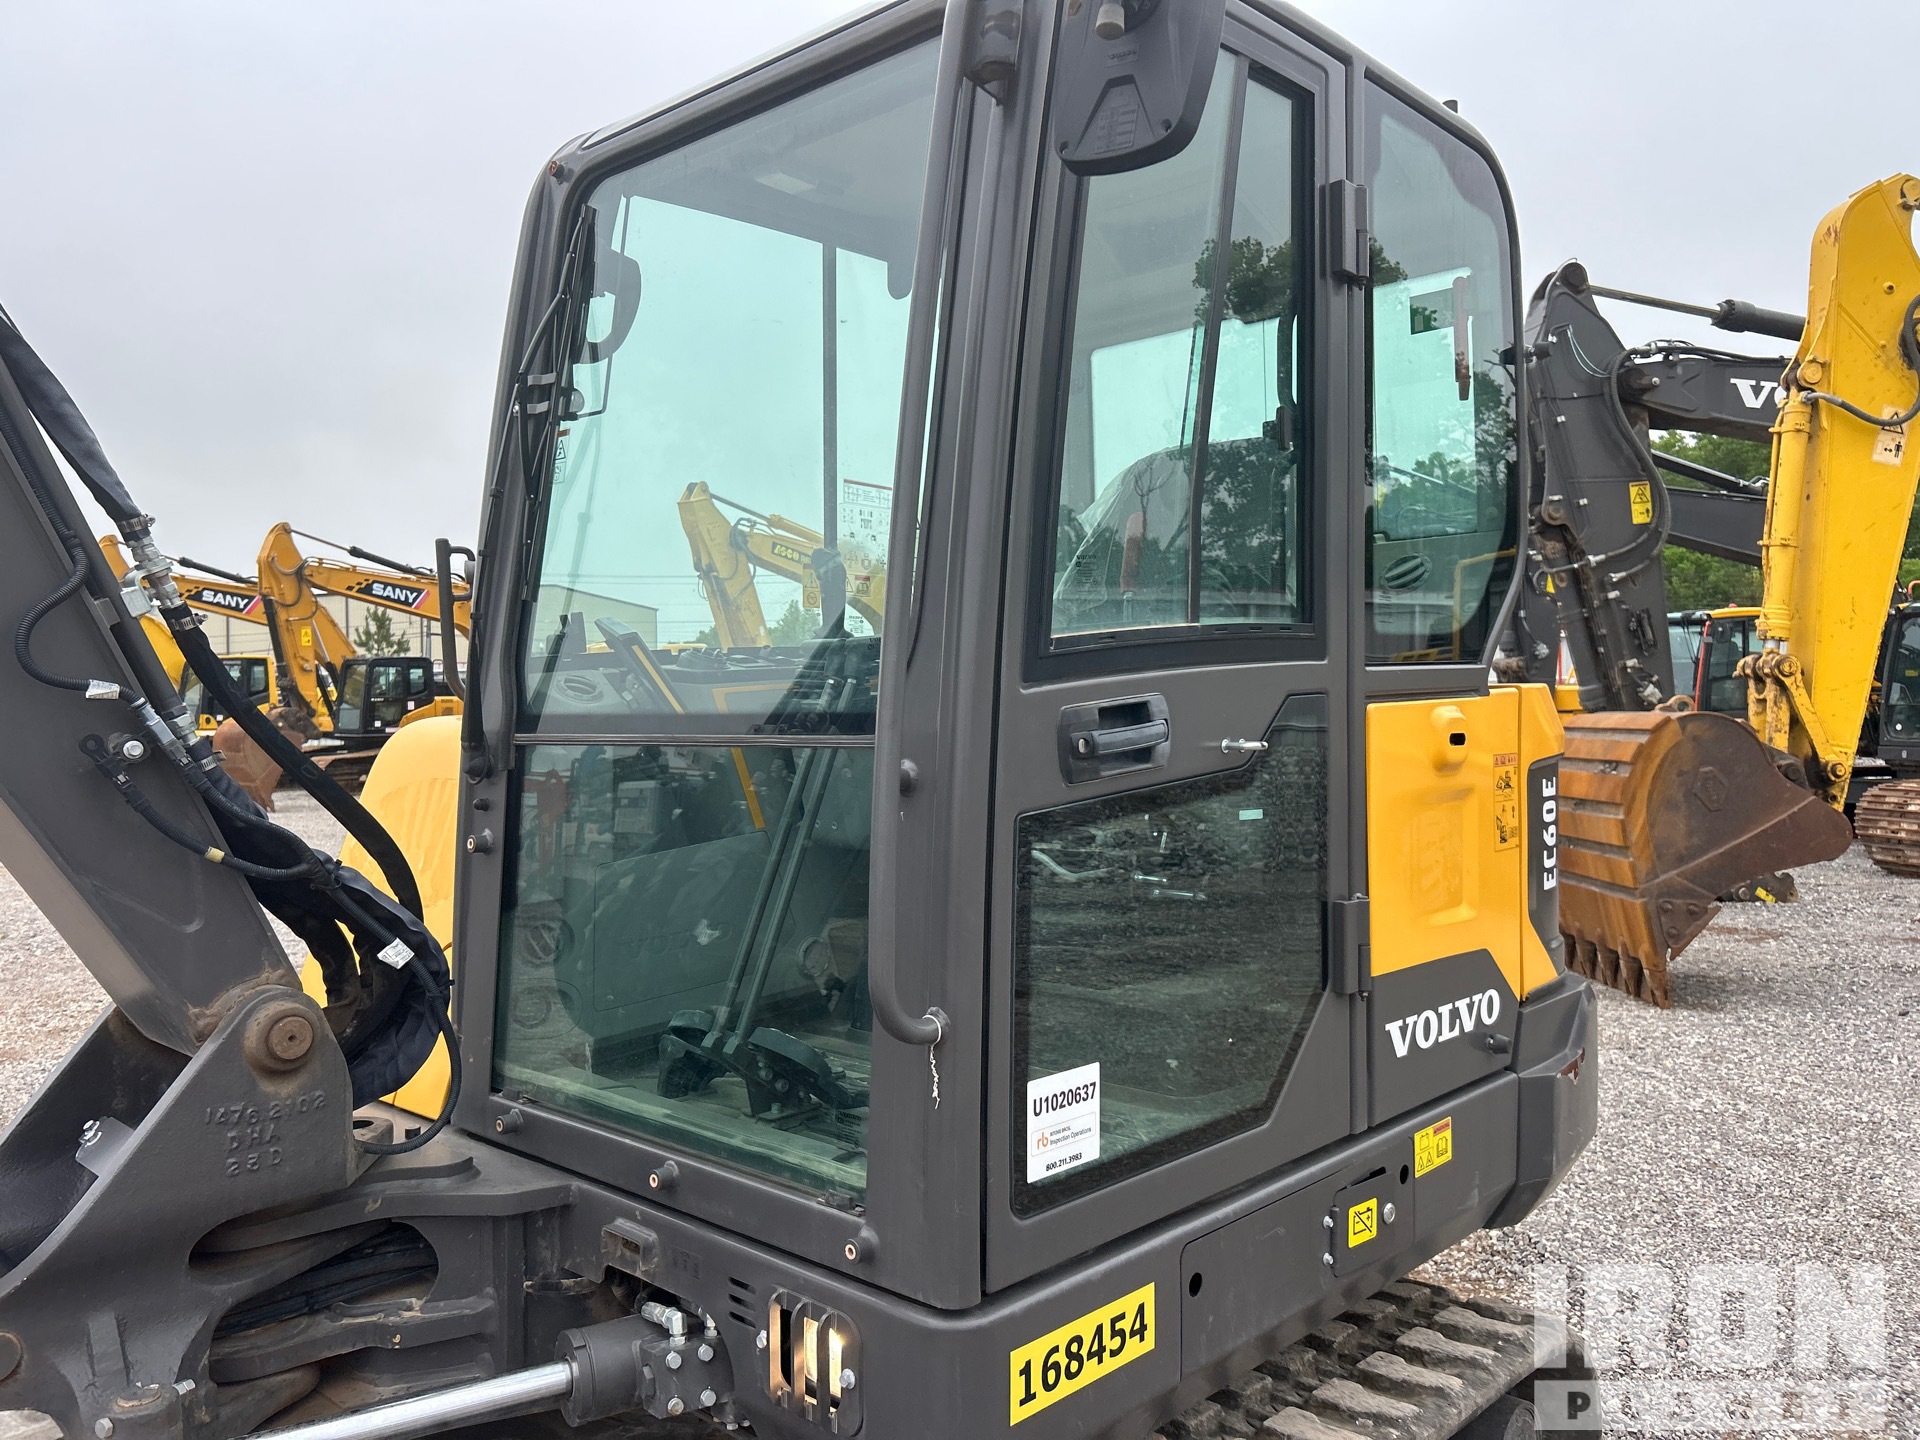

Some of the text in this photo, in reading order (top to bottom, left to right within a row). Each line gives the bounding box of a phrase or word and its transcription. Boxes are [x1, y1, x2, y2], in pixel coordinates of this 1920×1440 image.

[773, 544, 800, 561] ASCO
[202, 589, 250, 609] SANY
[371, 582, 419, 603] SANY
[1542, 776, 1557, 891] EC60E
[1384, 988, 1500, 1058] VOLVO
[1033, 1081, 1097, 1117] U1020637
[1037, 1131, 1049, 1150] rb
[1050, 1127, 1092, 1146] Inspection Operations
[1046, 1152, 1083, 1172] 800.211.3983
[1019, 1301, 1148, 1408] 168454
